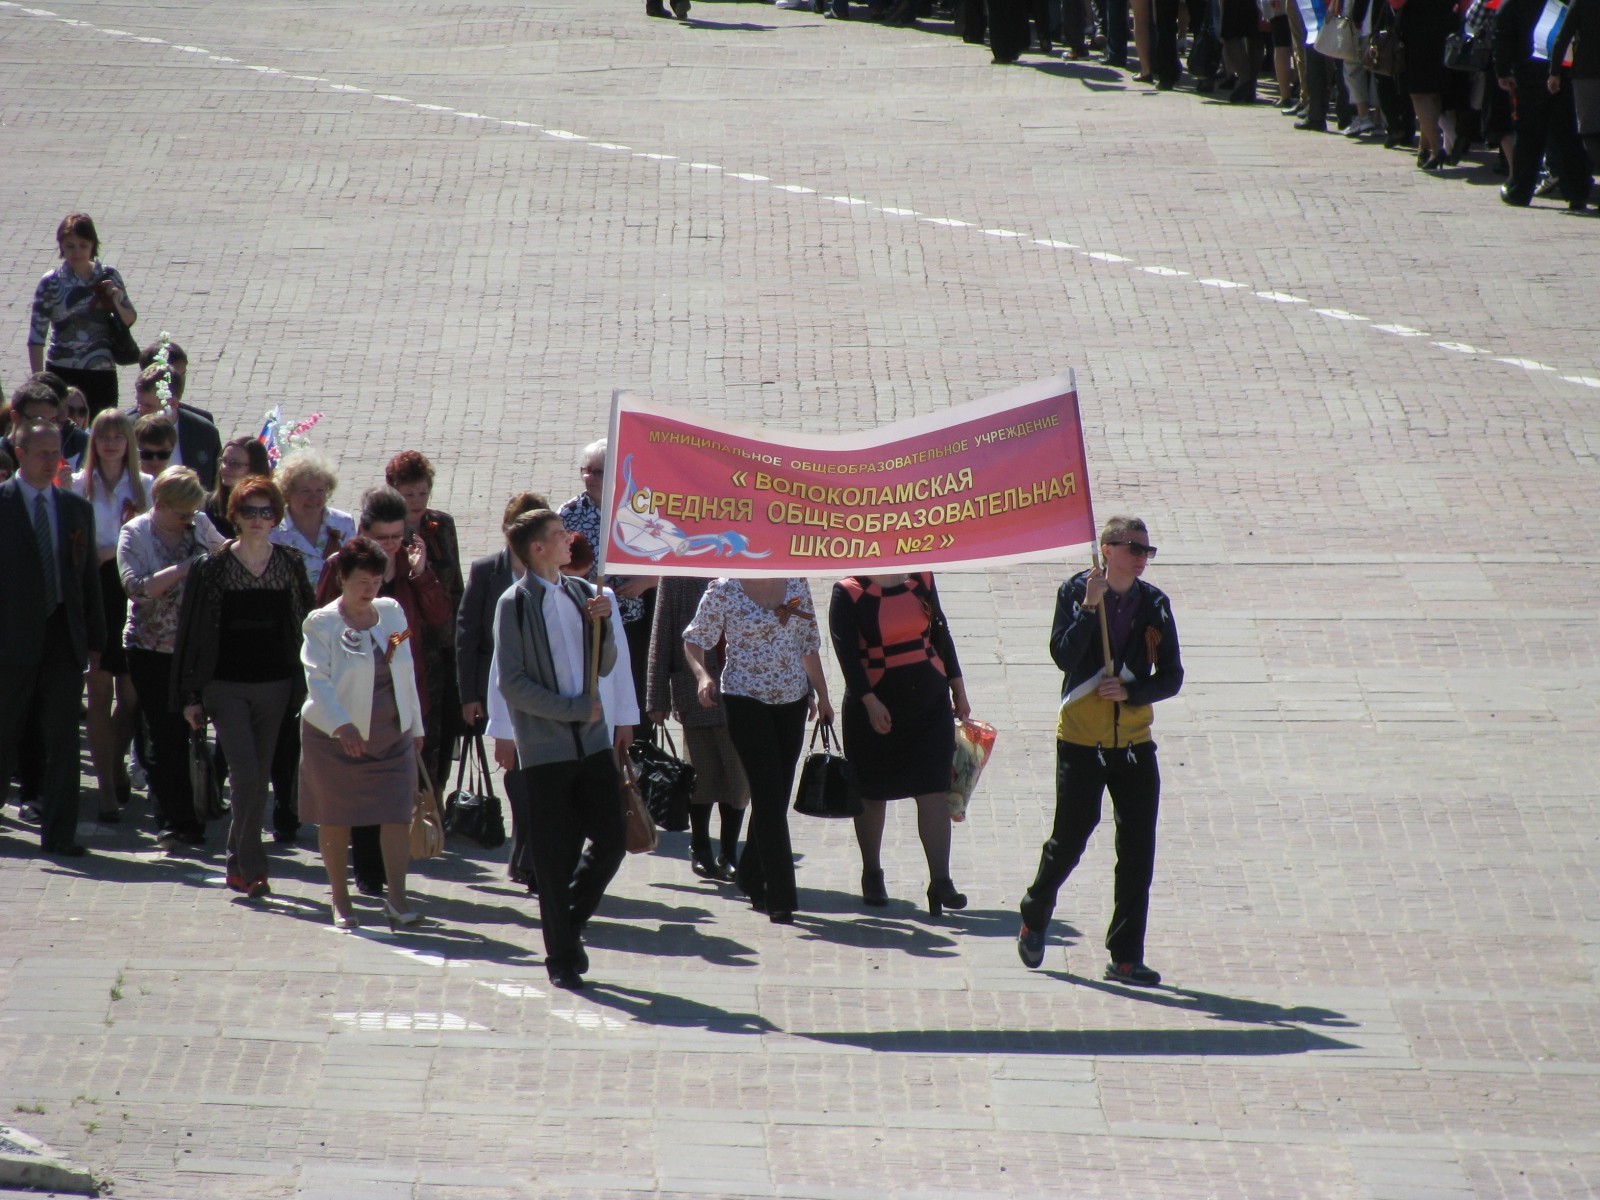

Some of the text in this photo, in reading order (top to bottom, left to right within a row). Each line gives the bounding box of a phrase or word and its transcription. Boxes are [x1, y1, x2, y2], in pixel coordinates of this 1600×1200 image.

[648, 414, 1060, 475] МУНИЦИПАЛЬНОЕ ОБЩЕОБРАЗОВАТЕЛЬНОЕ УЧРЕЖДЕНИЕ
[631, 472, 1076, 533] СРЕДНЯЯ ОБЩЕОБРАЗОВАТЕЛЬНАЯ
[789, 534, 881, 558] ШКОЛА
